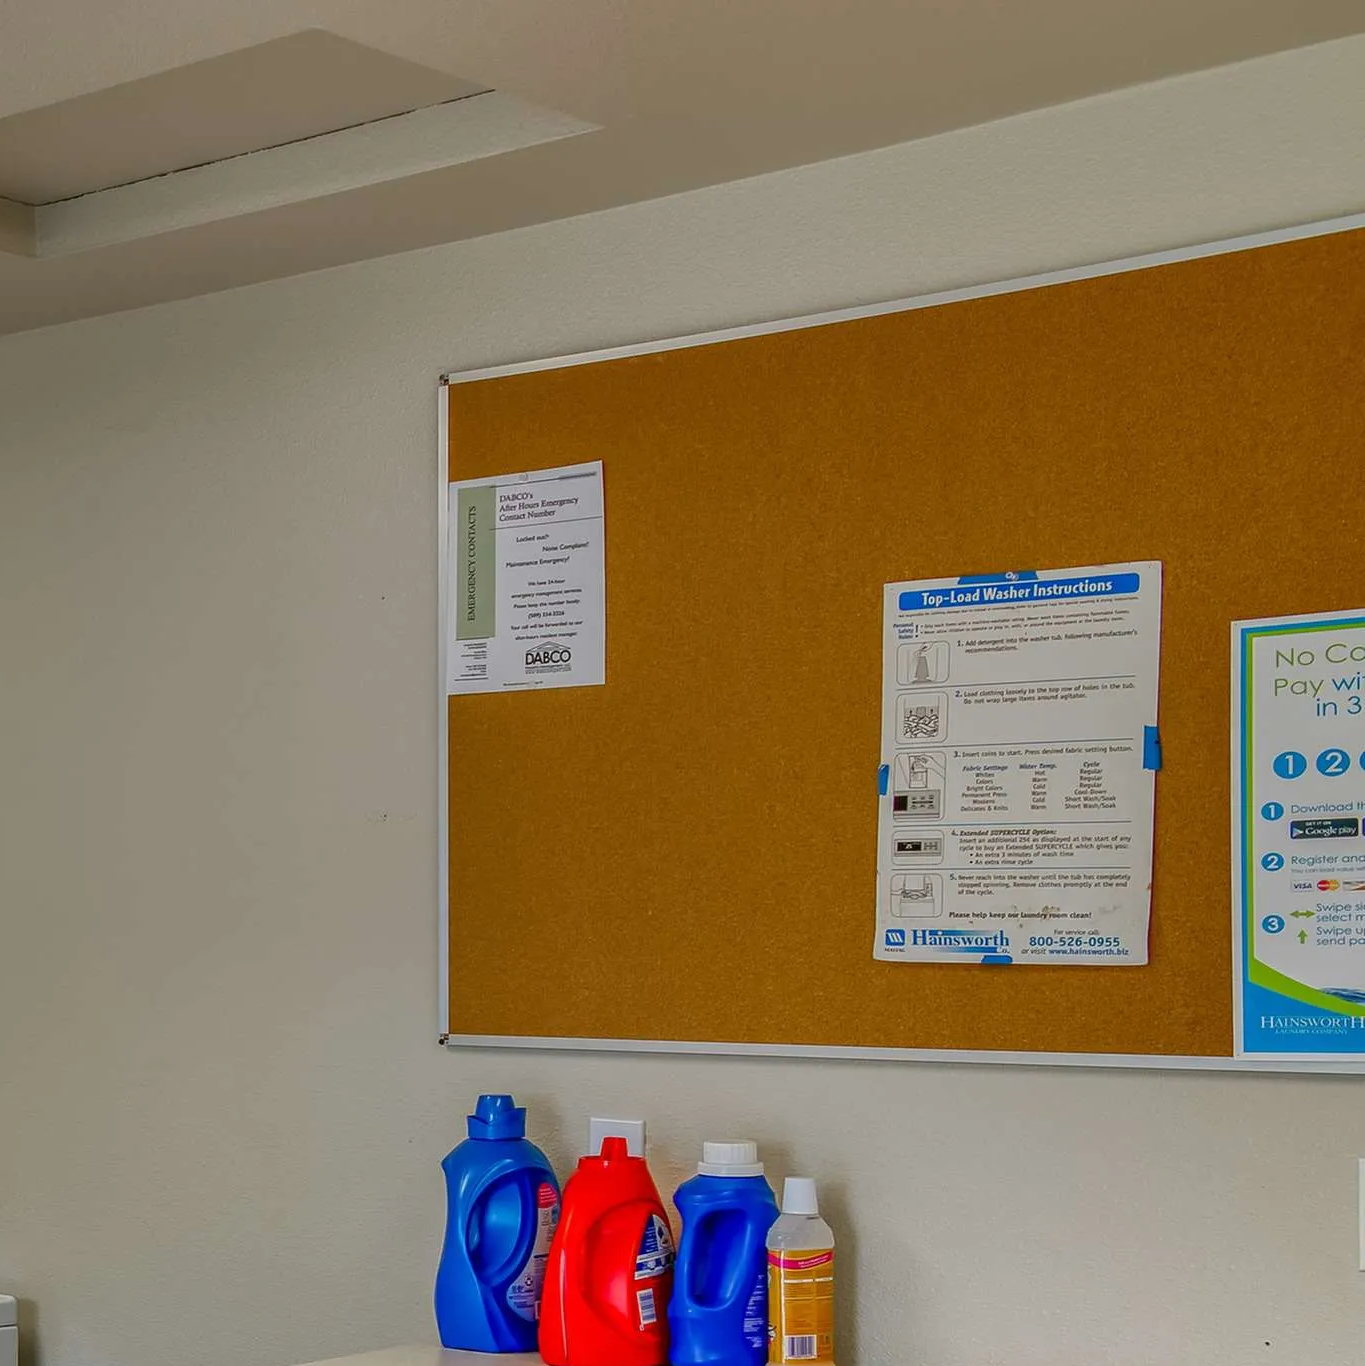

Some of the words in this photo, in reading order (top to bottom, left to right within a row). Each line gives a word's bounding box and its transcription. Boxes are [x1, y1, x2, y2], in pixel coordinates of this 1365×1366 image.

[499, 492, 533, 502] DABCO's
[499, 504, 516, 512] After
[518, 502, 539, 510] Hours
[541, 497, 579, 508] Emergency
[499, 512, 526, 522] Contact
[527, 510, 556, 519] Number
[469, 506, 477, 558] CONTACTS
[468, 560, 477, 621] EMERGENCY
[921, 588, 980, 607] Top-Load
[983, 586, 1031, 600] Washer
[1033, 580, 1113, 597] Instructions
[977, 638, 1004, 646] detergent
[1093, 629, 1137, 637] manufacturer's
[525, 649, 572, 665] DABCO
[1276, 647, 1315, 668] No
[1274, 678, 1324, 698] Pay
[1331, 671, 1365, 691] wi
[955, 690, 962, 698] 2.
[1316, 698, 1338, 717] in
[1347, 695, 1362, 715] 3
[953, 750, 961, 758] 3.
[1285, 754, 1294, 775] 1
[1325, 752, 1343, 774] 2
[1269, 804, 1275, 818] 1
[1291, 802, 1353, 814] Download
[1305, 826, 1337, 837] Google
[1338, 826, 1357, 836] play
[1267, 855, 1279, 869] 2
[1291, 855, 1339, 866] Register
[1316, 902, 1353, 914] Swipe
[1268, 917, 1279, 932] 3
[1316, 913, 1351, 922] select
[911, 930, 1010, 946] Hainsworth
[1316, 925, 1353, 937] Swipe
[1029, 936, 1120, 947] 800-526-0955
[1316, 936, 1346, 946] send
[1049, 948, 1129, 956] www.hainsworth.biz
[1261, 1016, 1365, 1028] HAINSWORTH
